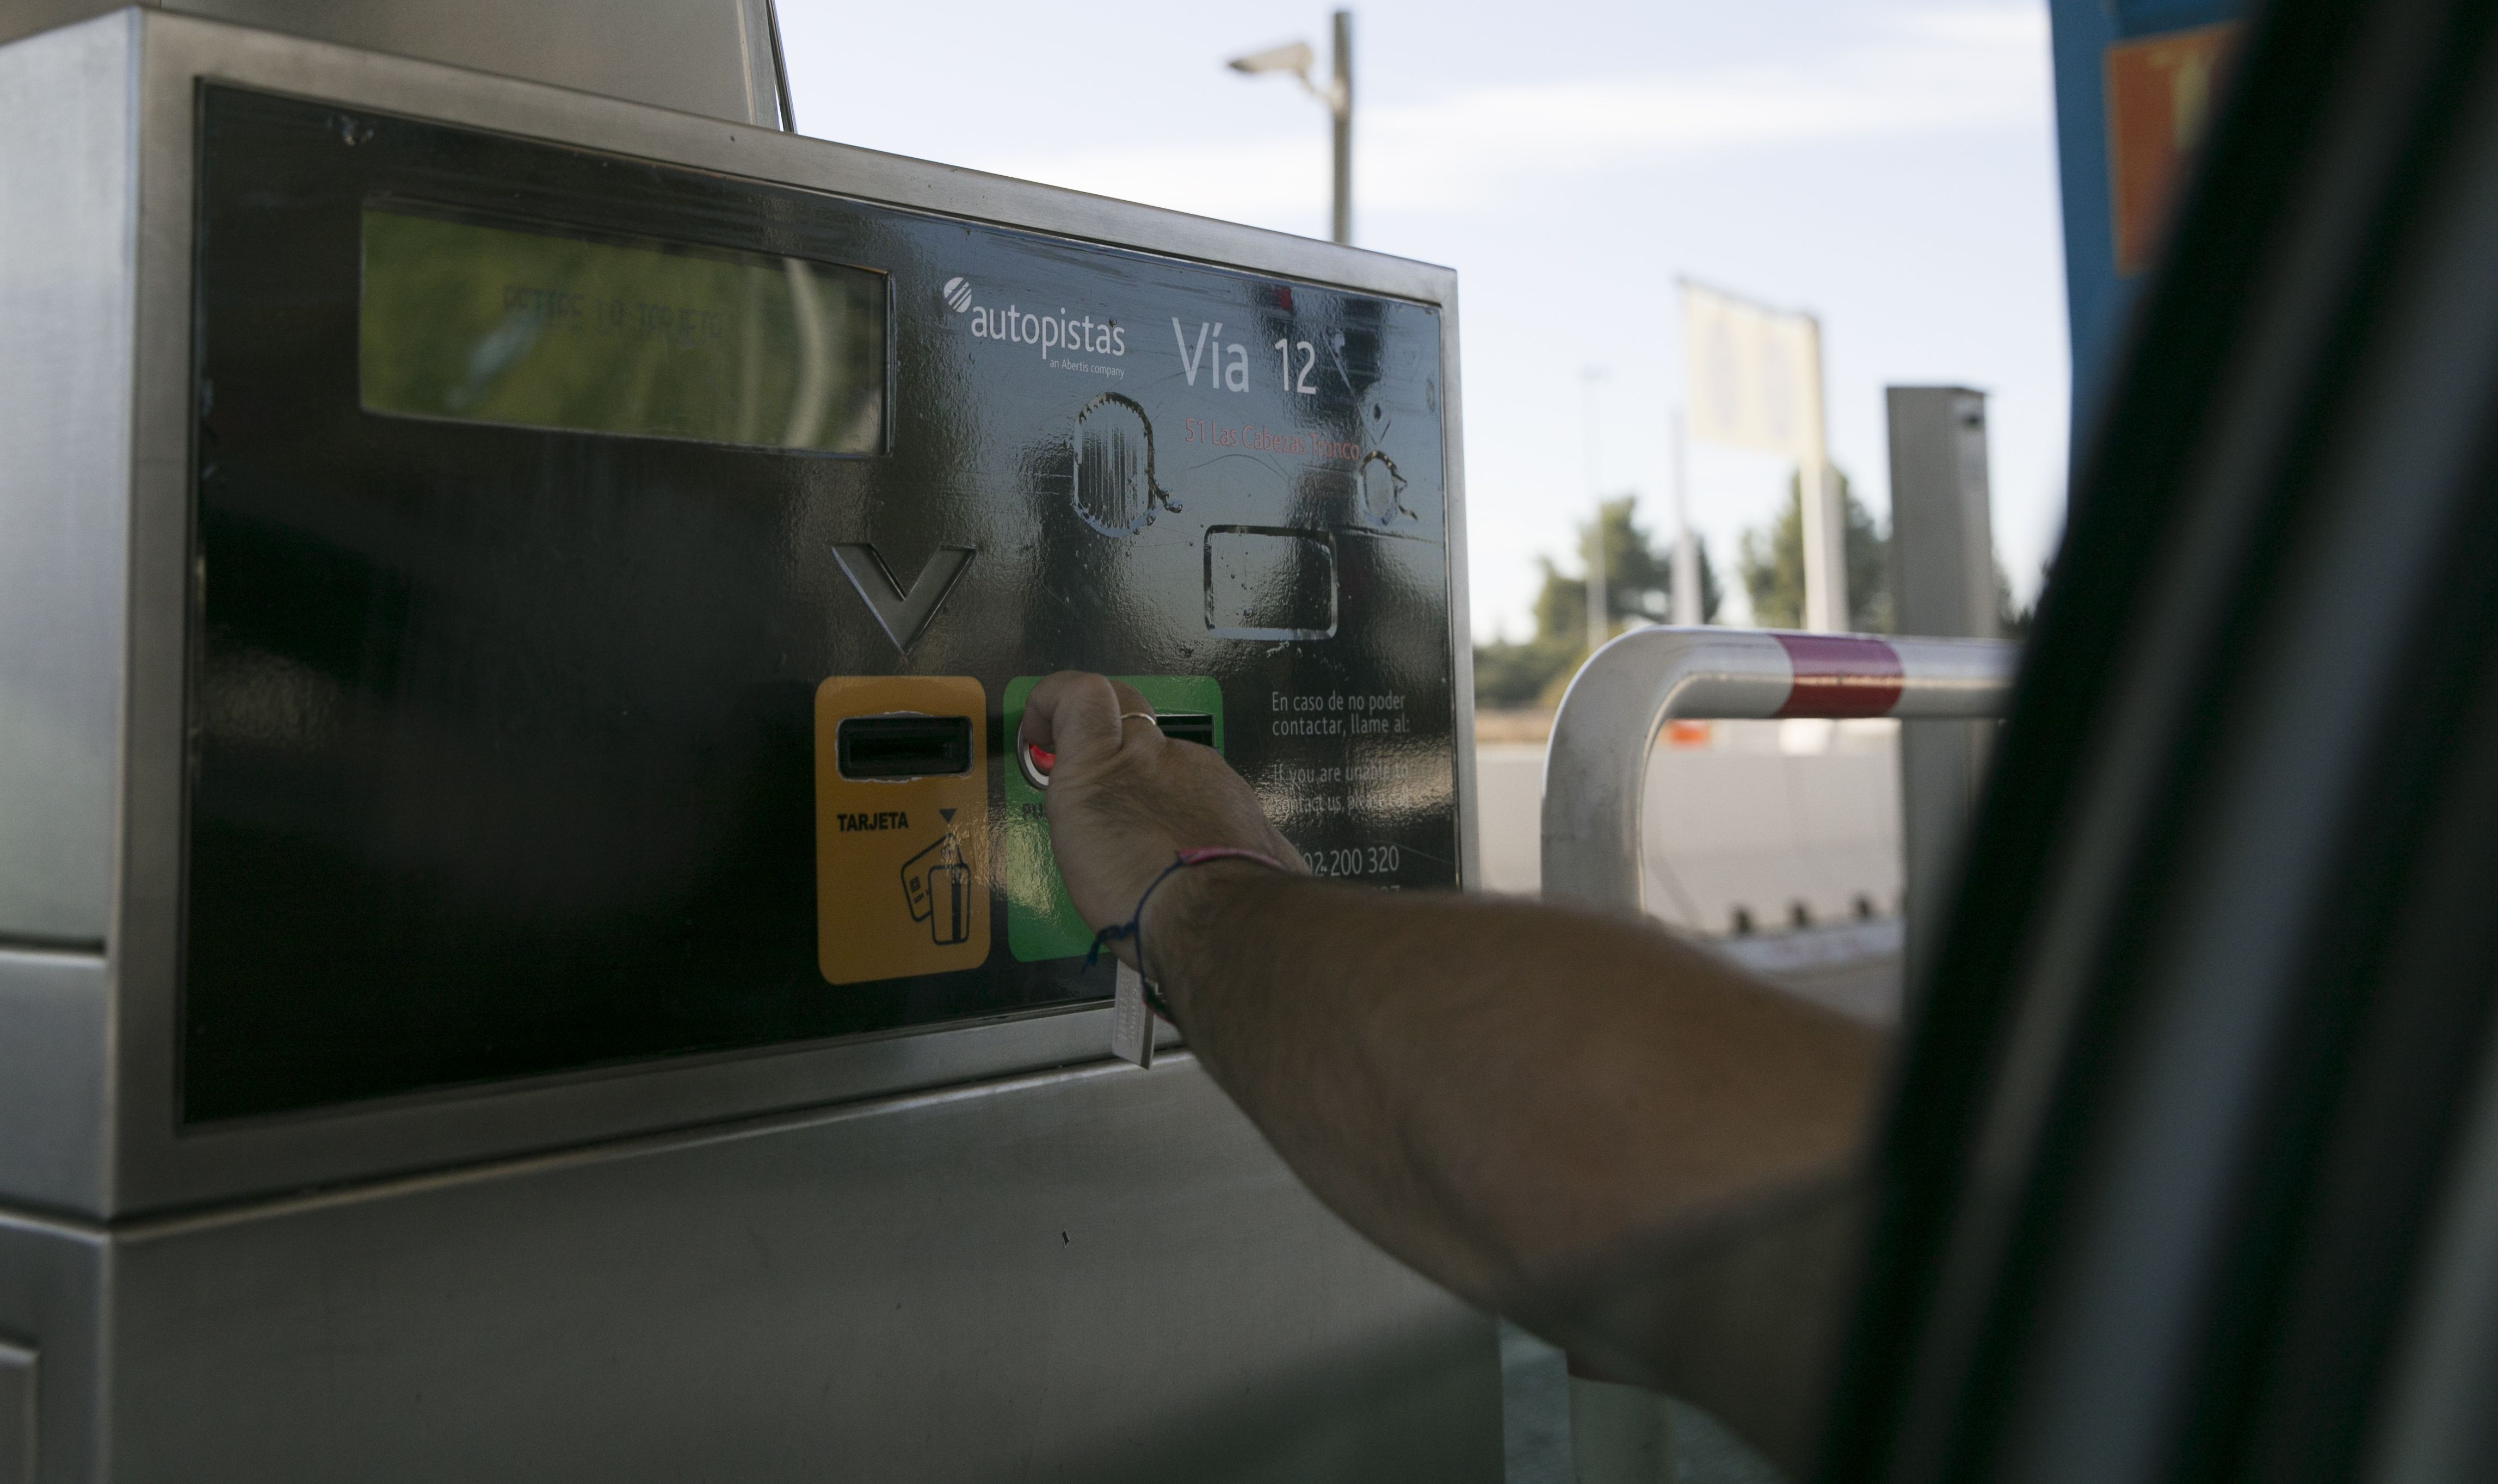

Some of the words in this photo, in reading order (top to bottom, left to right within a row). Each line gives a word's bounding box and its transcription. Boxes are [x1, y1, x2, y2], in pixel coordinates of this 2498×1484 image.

[971, 304, 1125, 360] autopistas
[1050, 360, 1059, 368] an
[1062, 358, 1089, 372] Abertis
[1090, 365, 1125, 380] company
[1171, 317, 1249, 393] Vía
[1274, 338, 1317, 394] 12
[1185, 418, 1205, 444] 51
[1212, 421, 1237, 448] Las
[1242, 425, 1306, 455] Cabezas
[1309, 433, 1359, 461] Tronco
[1272, 691, 1288, 712] En
[1293, 697, 1323, 710] caso
[1328, 690, 1343, 710] de
[1348, 696, 1364, 710] no
[1369, 690, 1405, 715] poder
[1272, 718, 1346, 737] contactar,
[1351, 714, 1389, 734] llame
[1394, 713, 1410, 733] al:
[1273, 763, 1283, 784] If
[1290, 767, 1314, 793] you
[1320, 767, 1341, 782] are
[1346, 763, 1390, 782] unable
[1395, 762, 1409, 778] to
[1275, 794, 1322, 813] contact
[1347, 792, 1385, 815] please
[837, 812, 909, 832] TARJETA
[1303, 852, 1324, 876] 02
[1330, 849, 1362, 876] 200
[1367, 845, 1399, 874] 320
